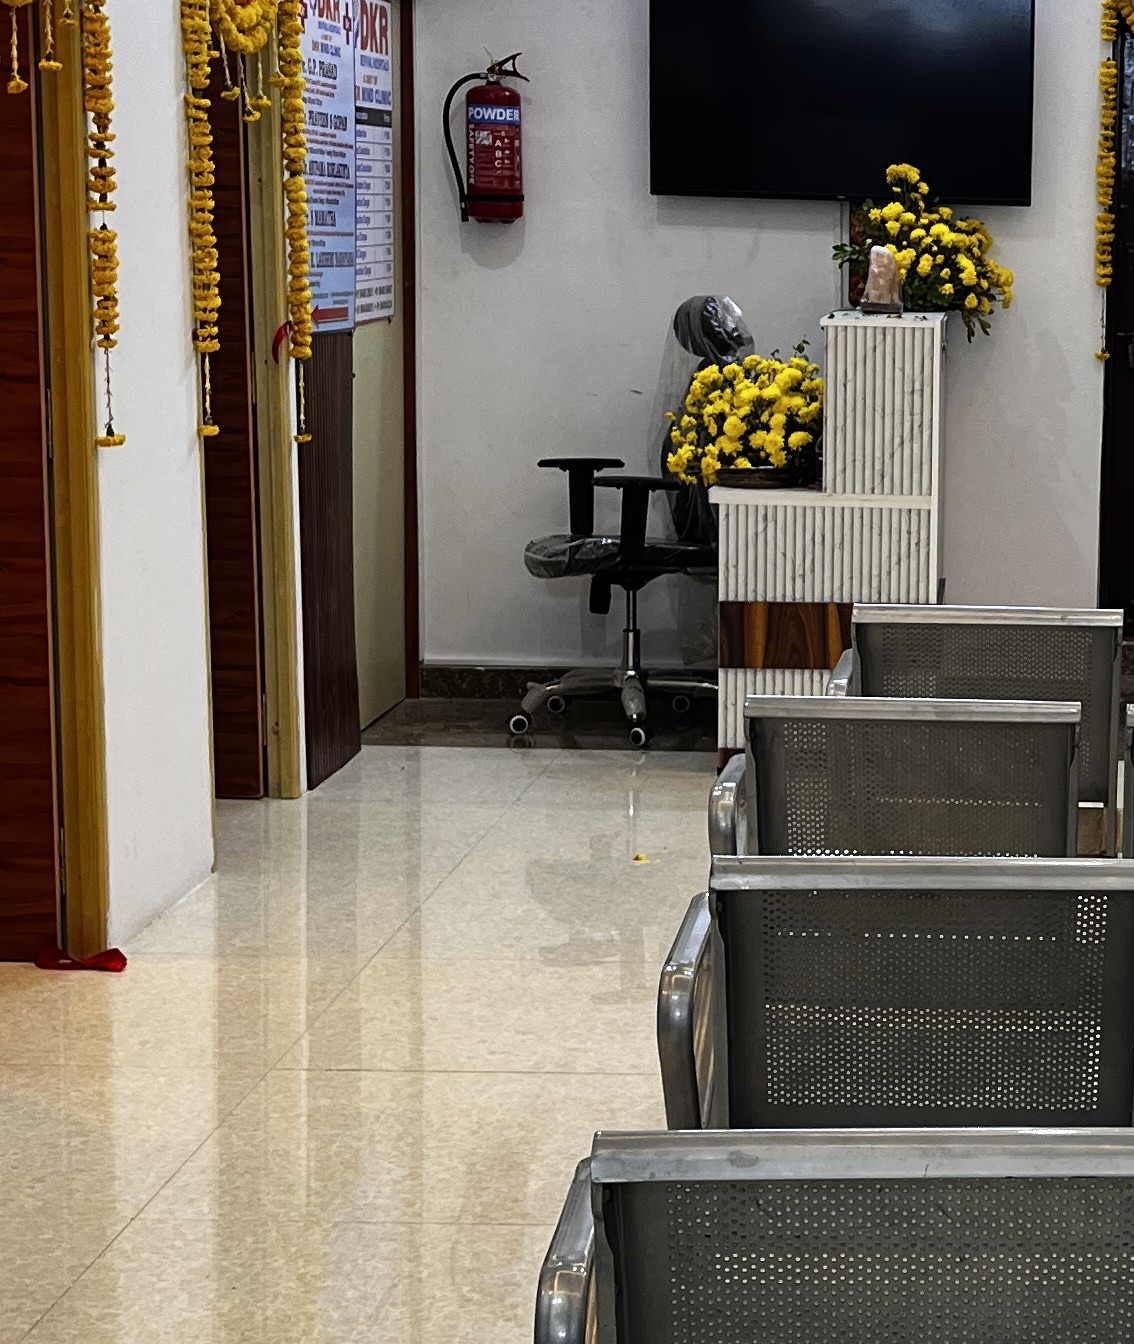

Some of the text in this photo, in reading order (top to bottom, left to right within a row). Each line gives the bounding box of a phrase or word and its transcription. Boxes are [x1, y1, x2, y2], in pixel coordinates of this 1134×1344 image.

[360, 0, 388, 55] DKR
[468, 106, 520, 121] POWDER
[494, 139, 502, 147] A
[495, 149, 503, 158] B
[494, 159, 502, 168] C
